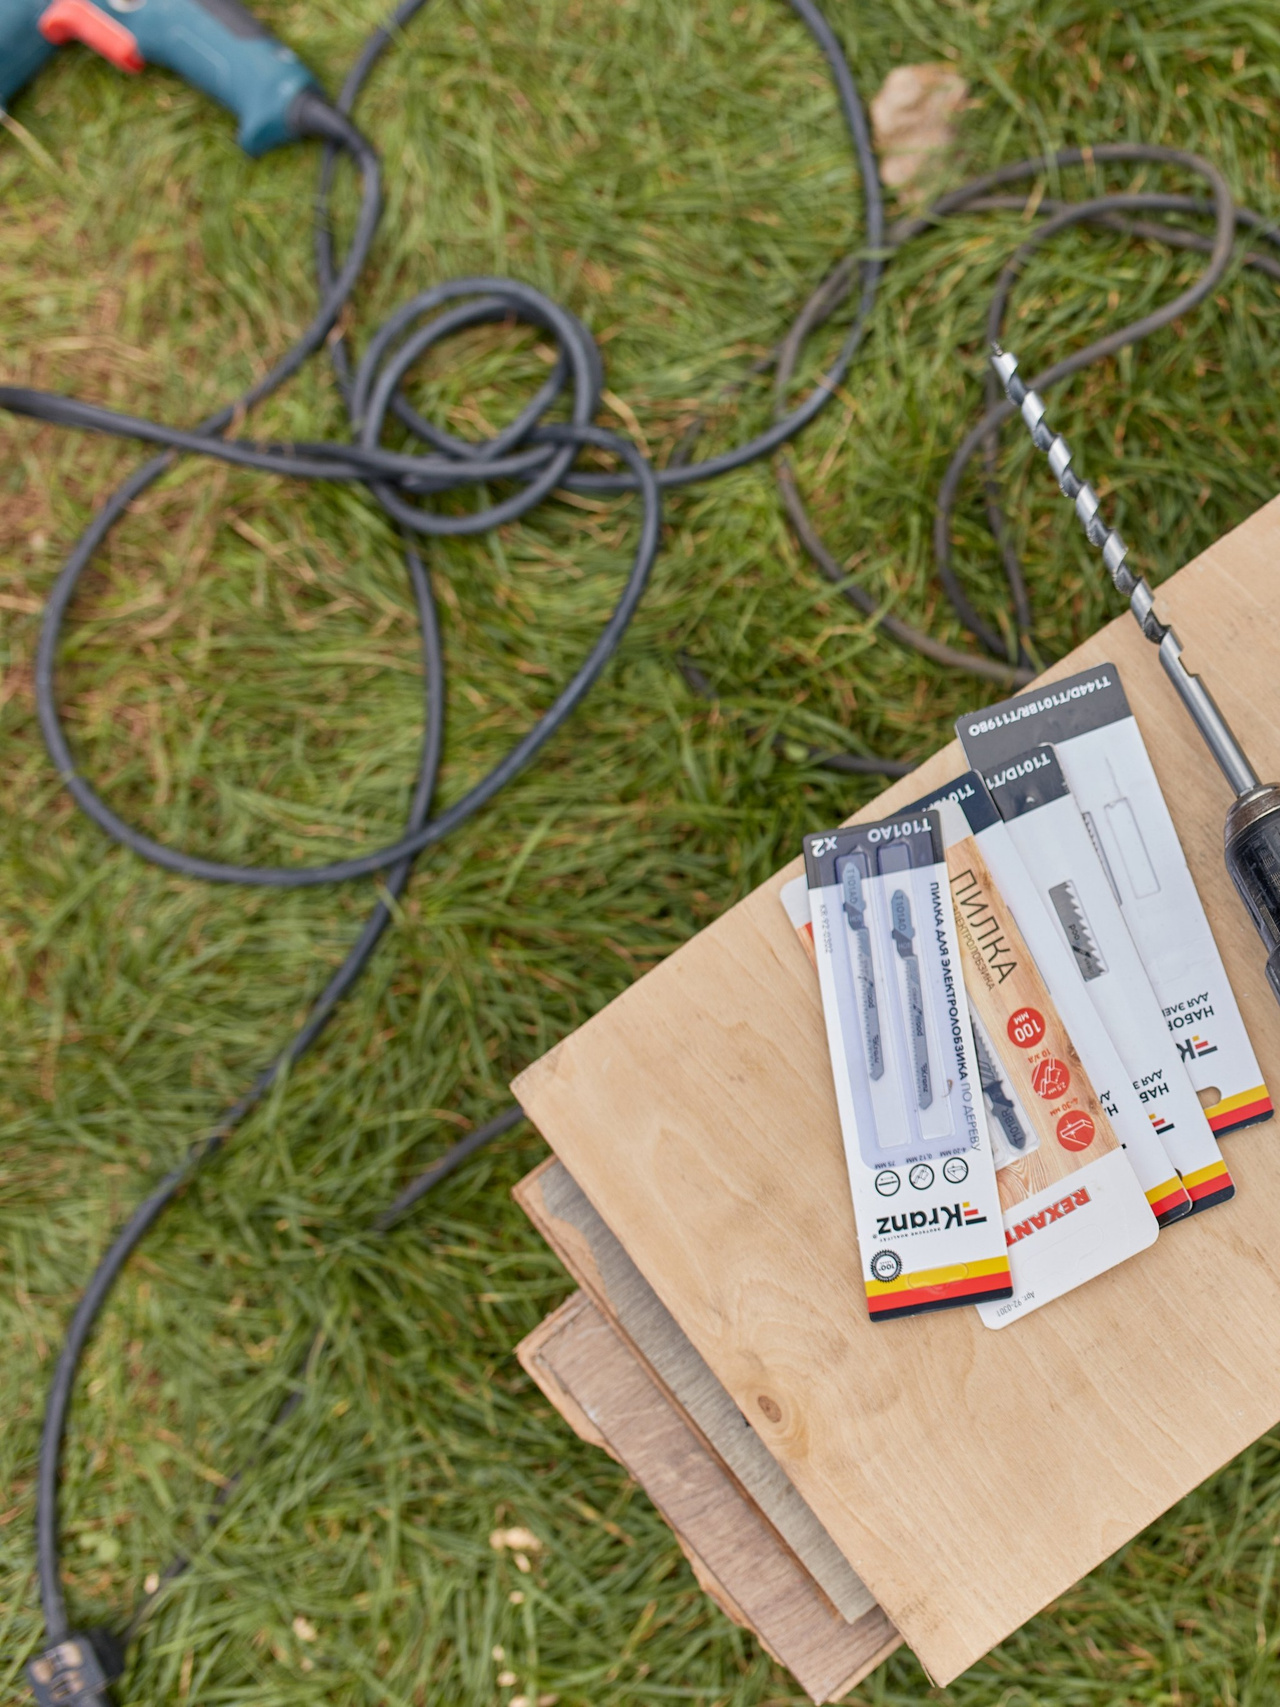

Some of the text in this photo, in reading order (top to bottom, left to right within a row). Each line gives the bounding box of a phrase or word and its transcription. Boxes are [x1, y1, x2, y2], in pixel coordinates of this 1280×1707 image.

[949, 869, 1018, 985] ПИЛКА
[1187, 991, 1209, 1008] ДЛЯ
[930, 881, 982, 1152] ПИЛКА ДЛЯ ЭЛЕКТРОЛОБЗИКА ПО ДЕРЕВУ
[1014, 1019, 1041, 1043] 100
[1141, 1069, 1163, 1087] ДЛЯ
[1001, 1108, 1024, 1144] T101BR
[876, 1203, 963, 1235] Kranz
